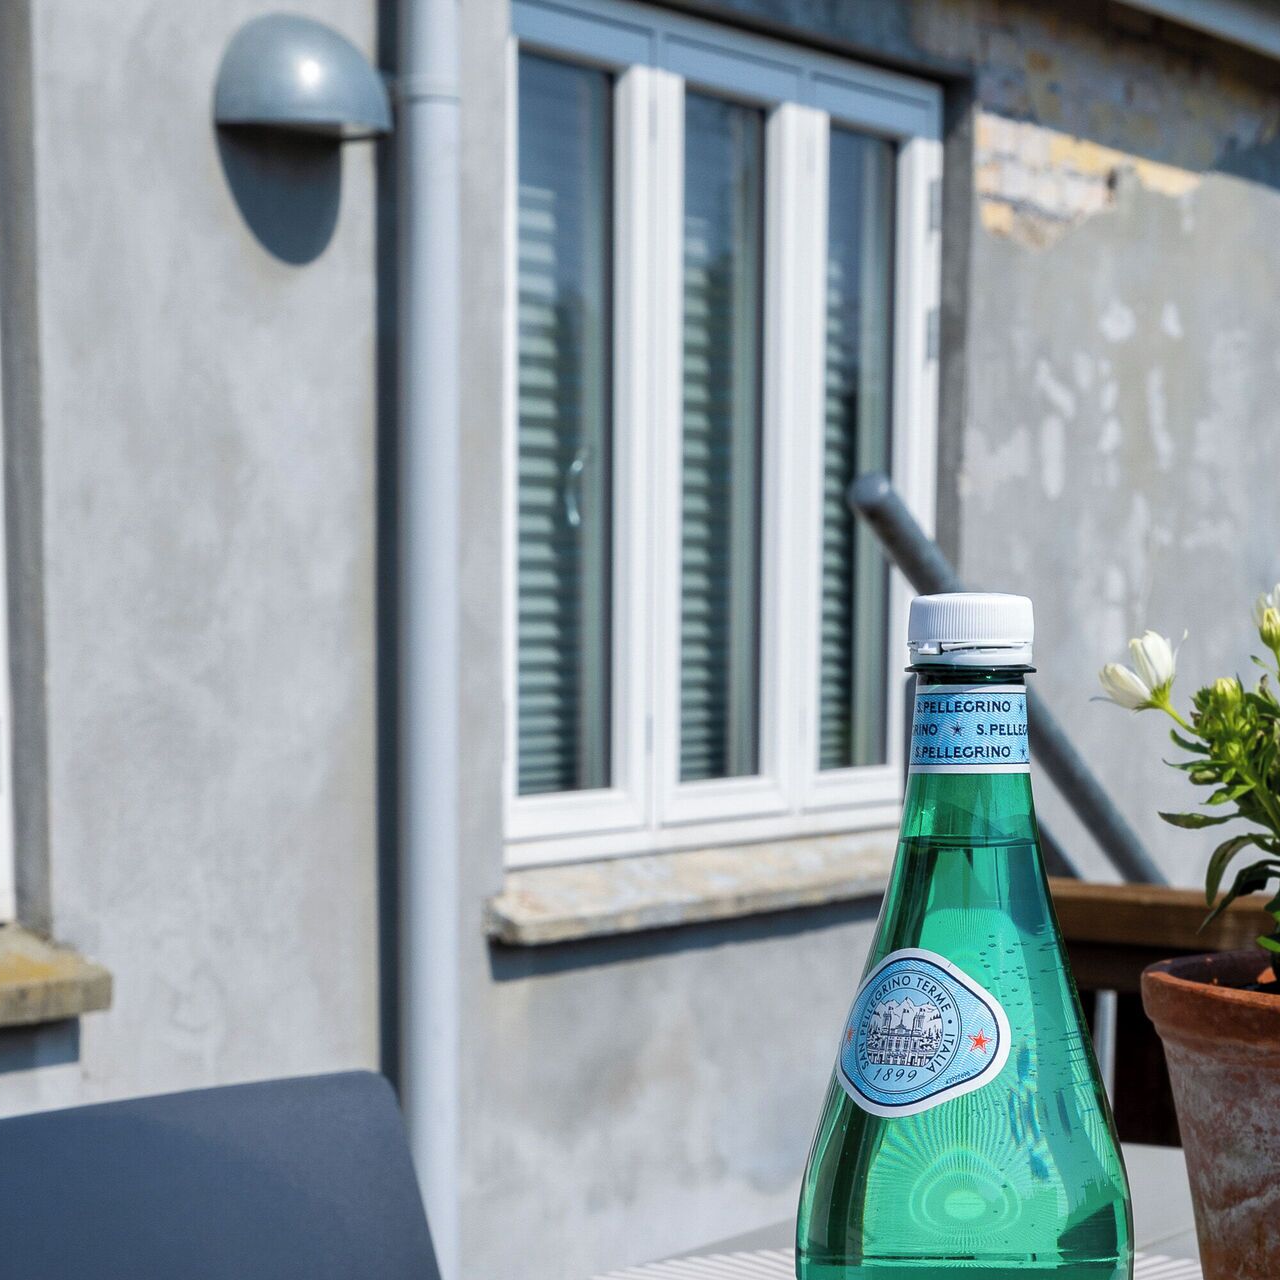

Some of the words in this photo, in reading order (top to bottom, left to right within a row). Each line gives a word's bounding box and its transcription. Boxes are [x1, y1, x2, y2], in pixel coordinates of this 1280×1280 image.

[860, 975, 911, 1037] PELLEGRINO
[916, 977, 952, 1012] TERME
[858, 1042, 870, 1070] SAN
[926, 1033, 956, 1073] ITALIA
[872, 1068, 918, 1083] 1899
